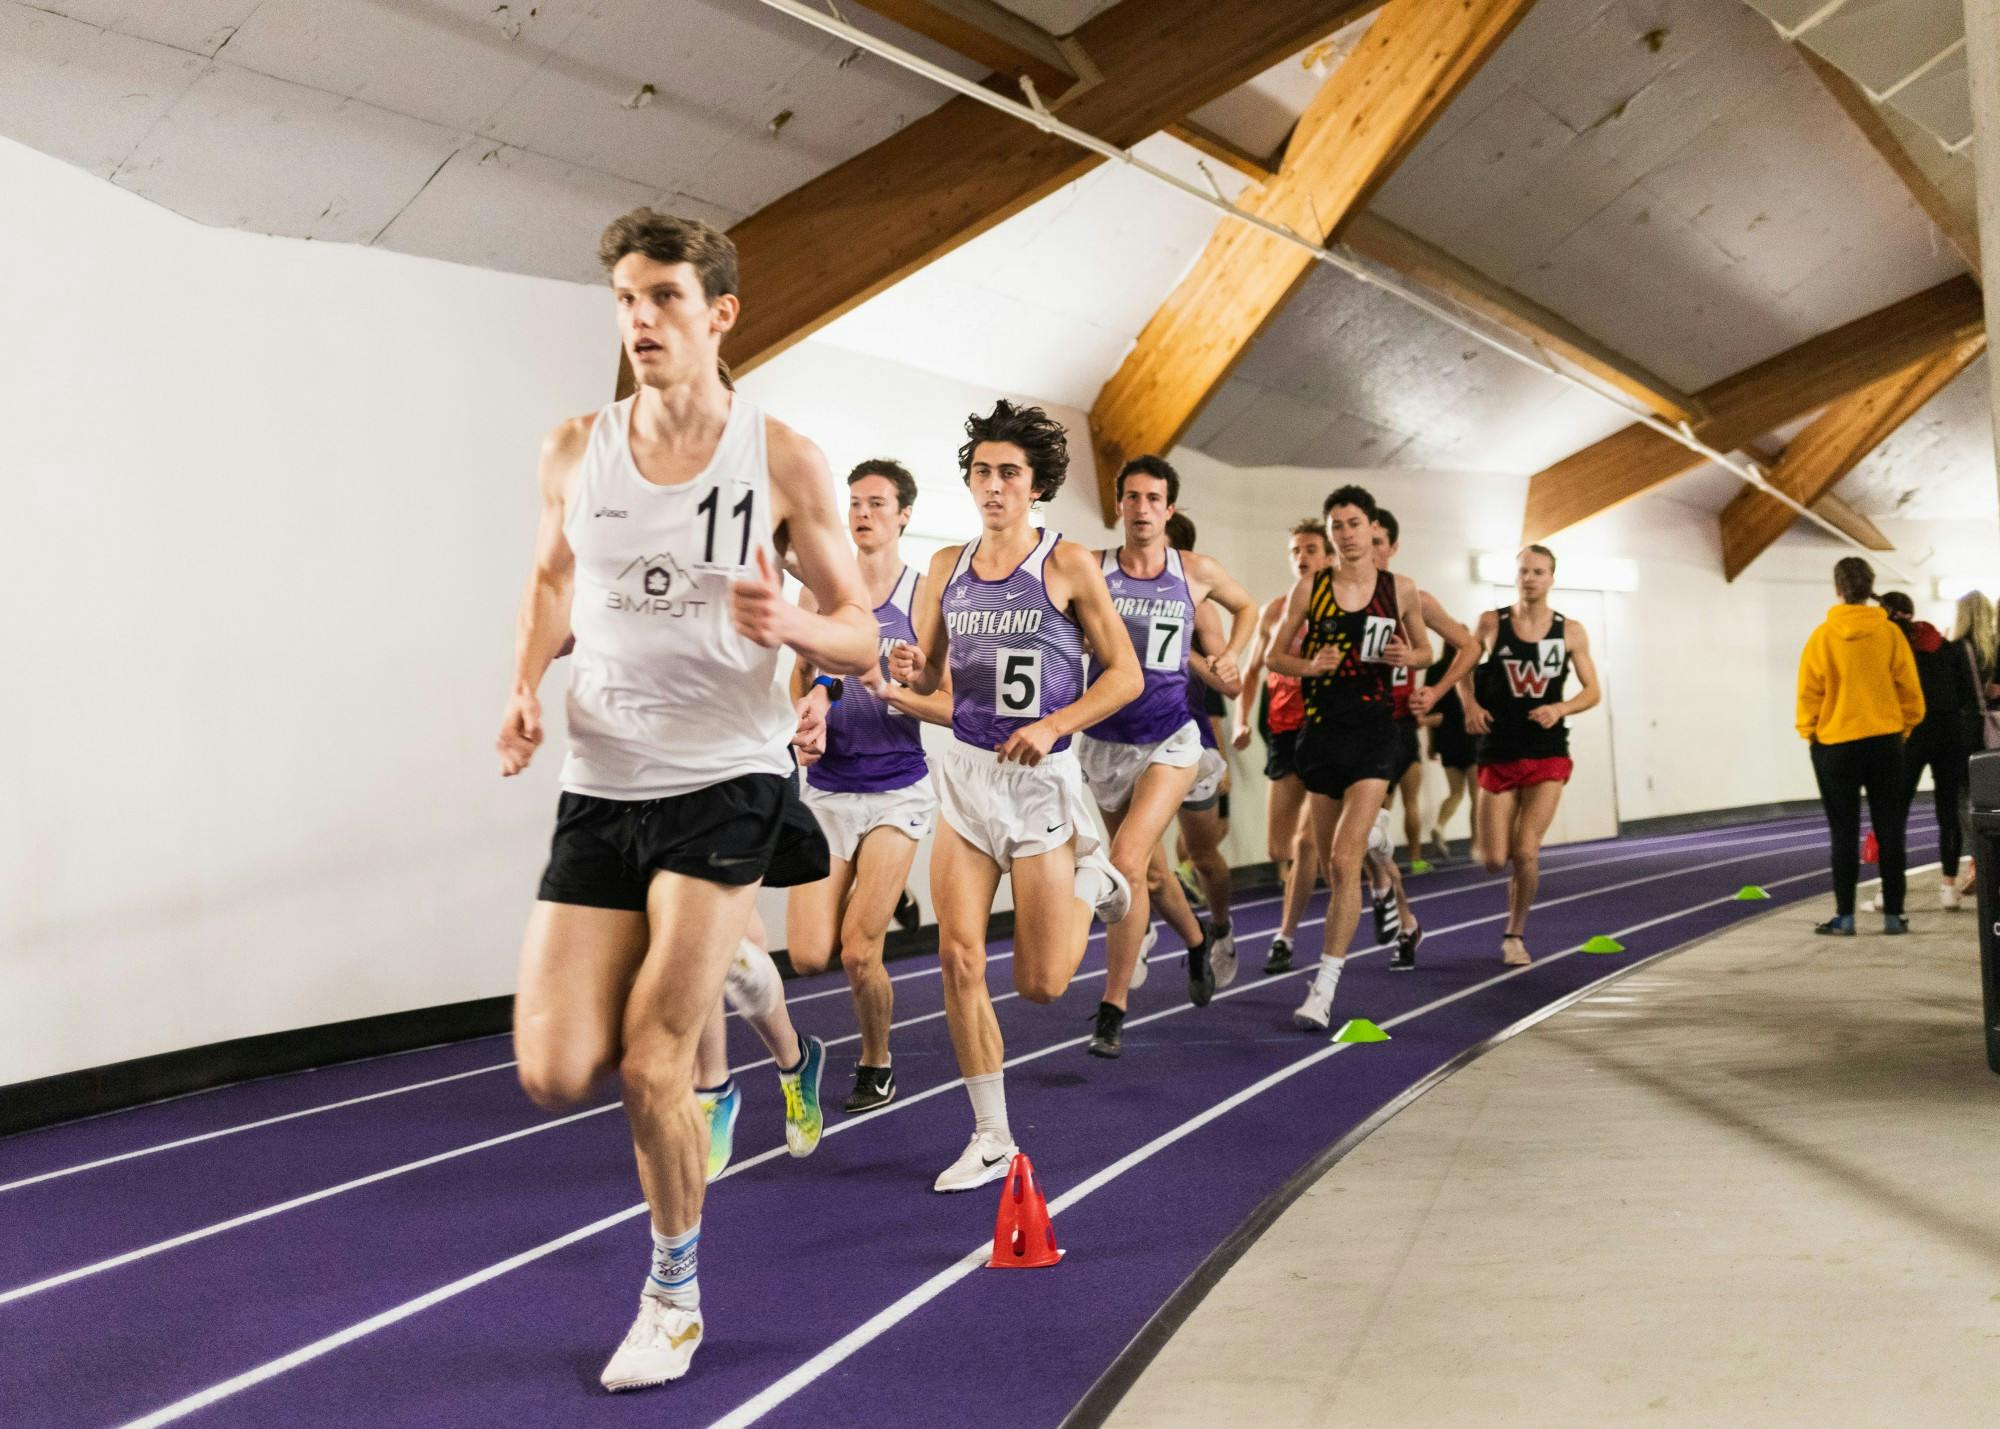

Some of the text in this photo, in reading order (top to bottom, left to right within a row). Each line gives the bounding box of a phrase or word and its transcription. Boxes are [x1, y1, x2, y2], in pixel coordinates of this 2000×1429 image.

[697, 486, 754, 565] 11
[948, 609, 1042, 636] PORTLAND
[1113, 598, 1186, 617] ORTLAND
[1155, 623, 1179, 663] 7
[1366, 622, 1392, 657] 10
[1543, 644, 1561, 672] 4
[1002, 655, 1035, 710] 5
[1502, 659, 1550, 699] W
